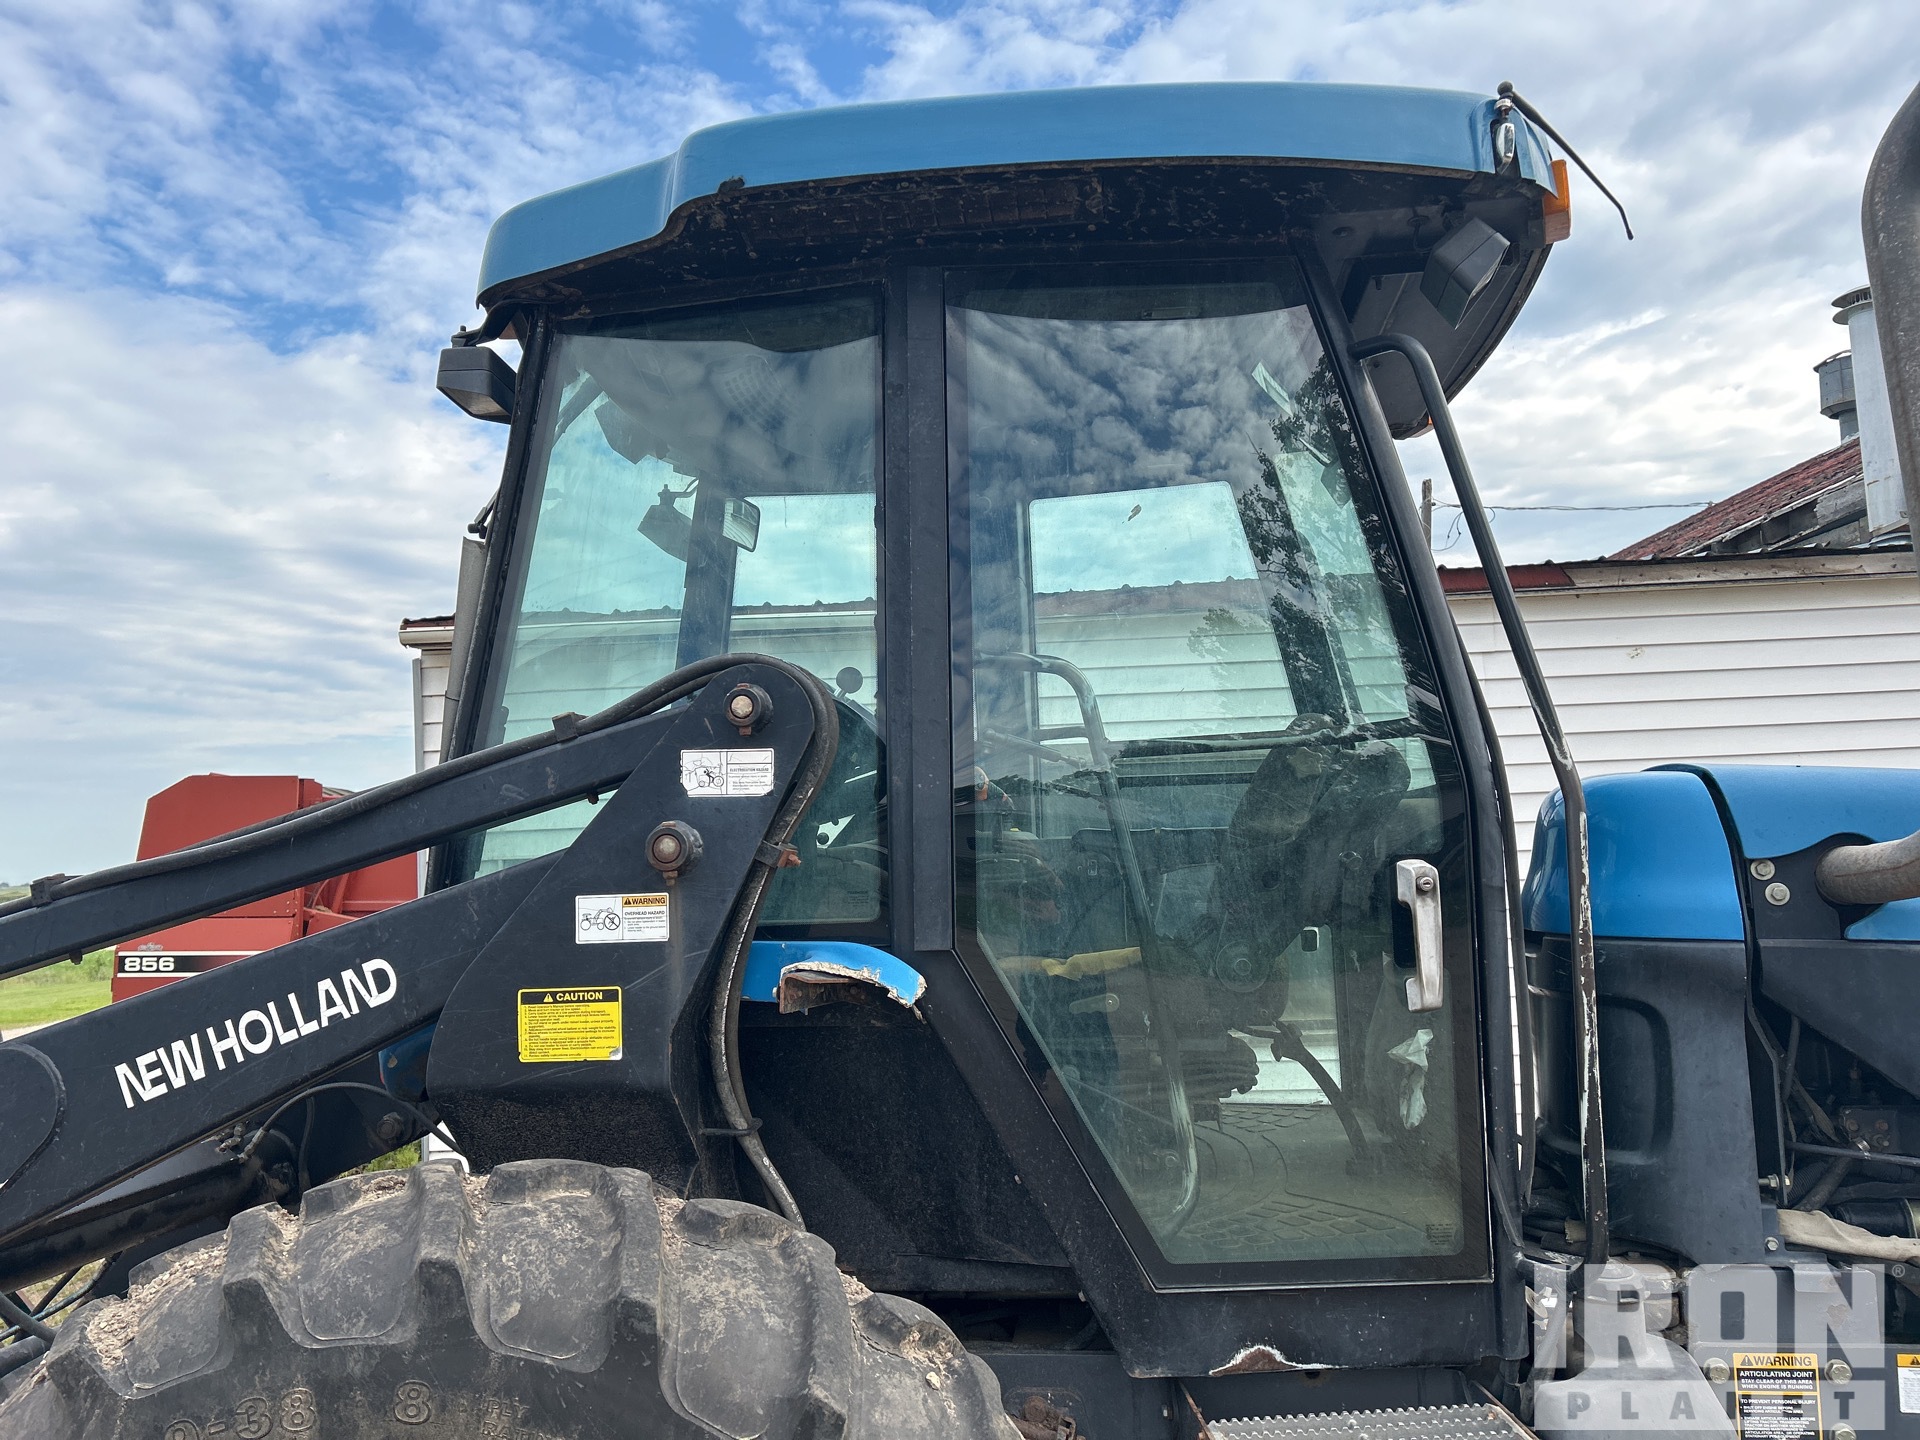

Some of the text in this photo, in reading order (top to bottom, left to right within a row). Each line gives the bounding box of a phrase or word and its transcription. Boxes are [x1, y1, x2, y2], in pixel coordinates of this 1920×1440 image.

[124, 956, 174, 972] 856
[556, 992, 603, 1001] CAUTION
[114, 958, 398, 1109] NEW HOLLAND
[1753, 1356, 1812, 1366] WARNING
[394, 1379, 432, 1426] 8
[484, 1398, 530, 1419] PLY
